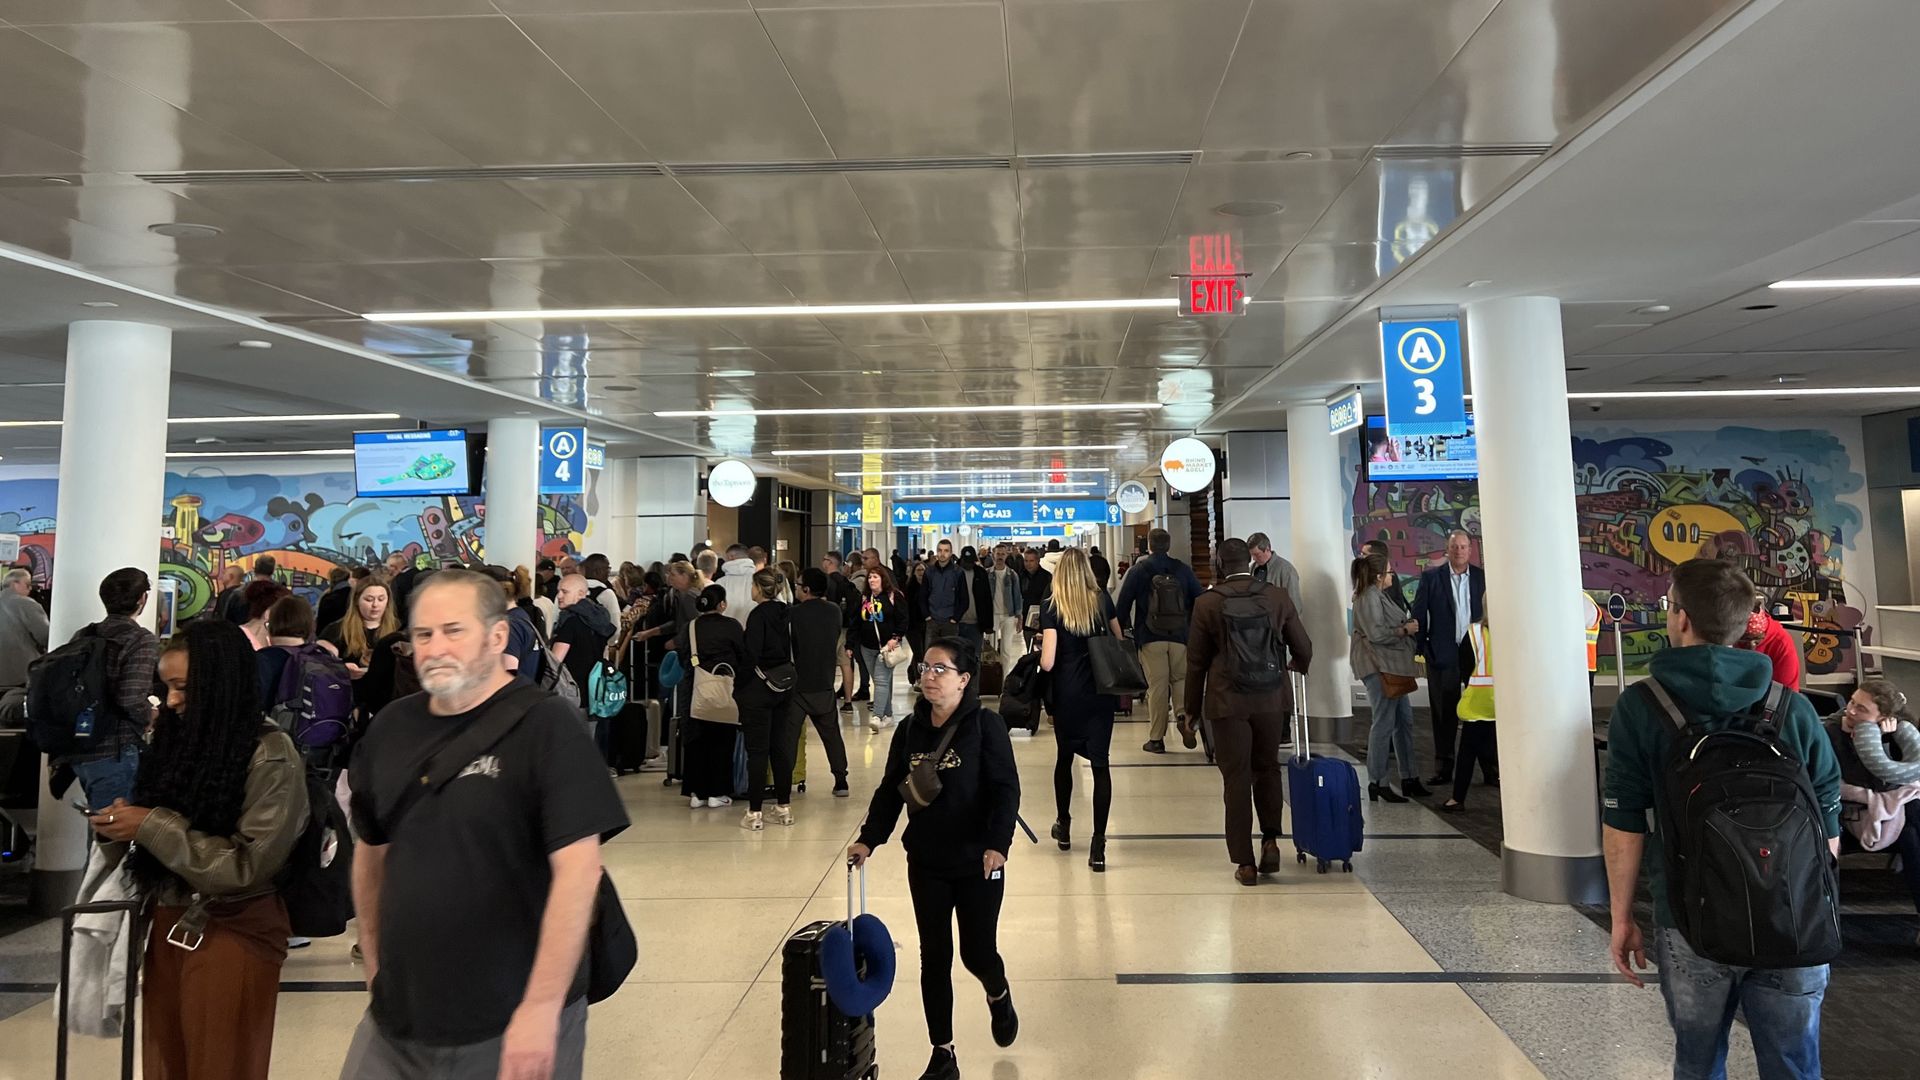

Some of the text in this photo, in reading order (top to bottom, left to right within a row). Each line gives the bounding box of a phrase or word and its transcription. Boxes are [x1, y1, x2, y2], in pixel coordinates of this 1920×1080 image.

[1190, 279, 1236, 312] EXIT
[1410, 337, 1435, 363] A
[1413, 378, 1437, 415] 3
[556, 437, 570, 452] A
[555, 460, 570, 481] 4
[982, 509, 1012, 519] A5-A13
[1111, 514, 1117, 523] 5
